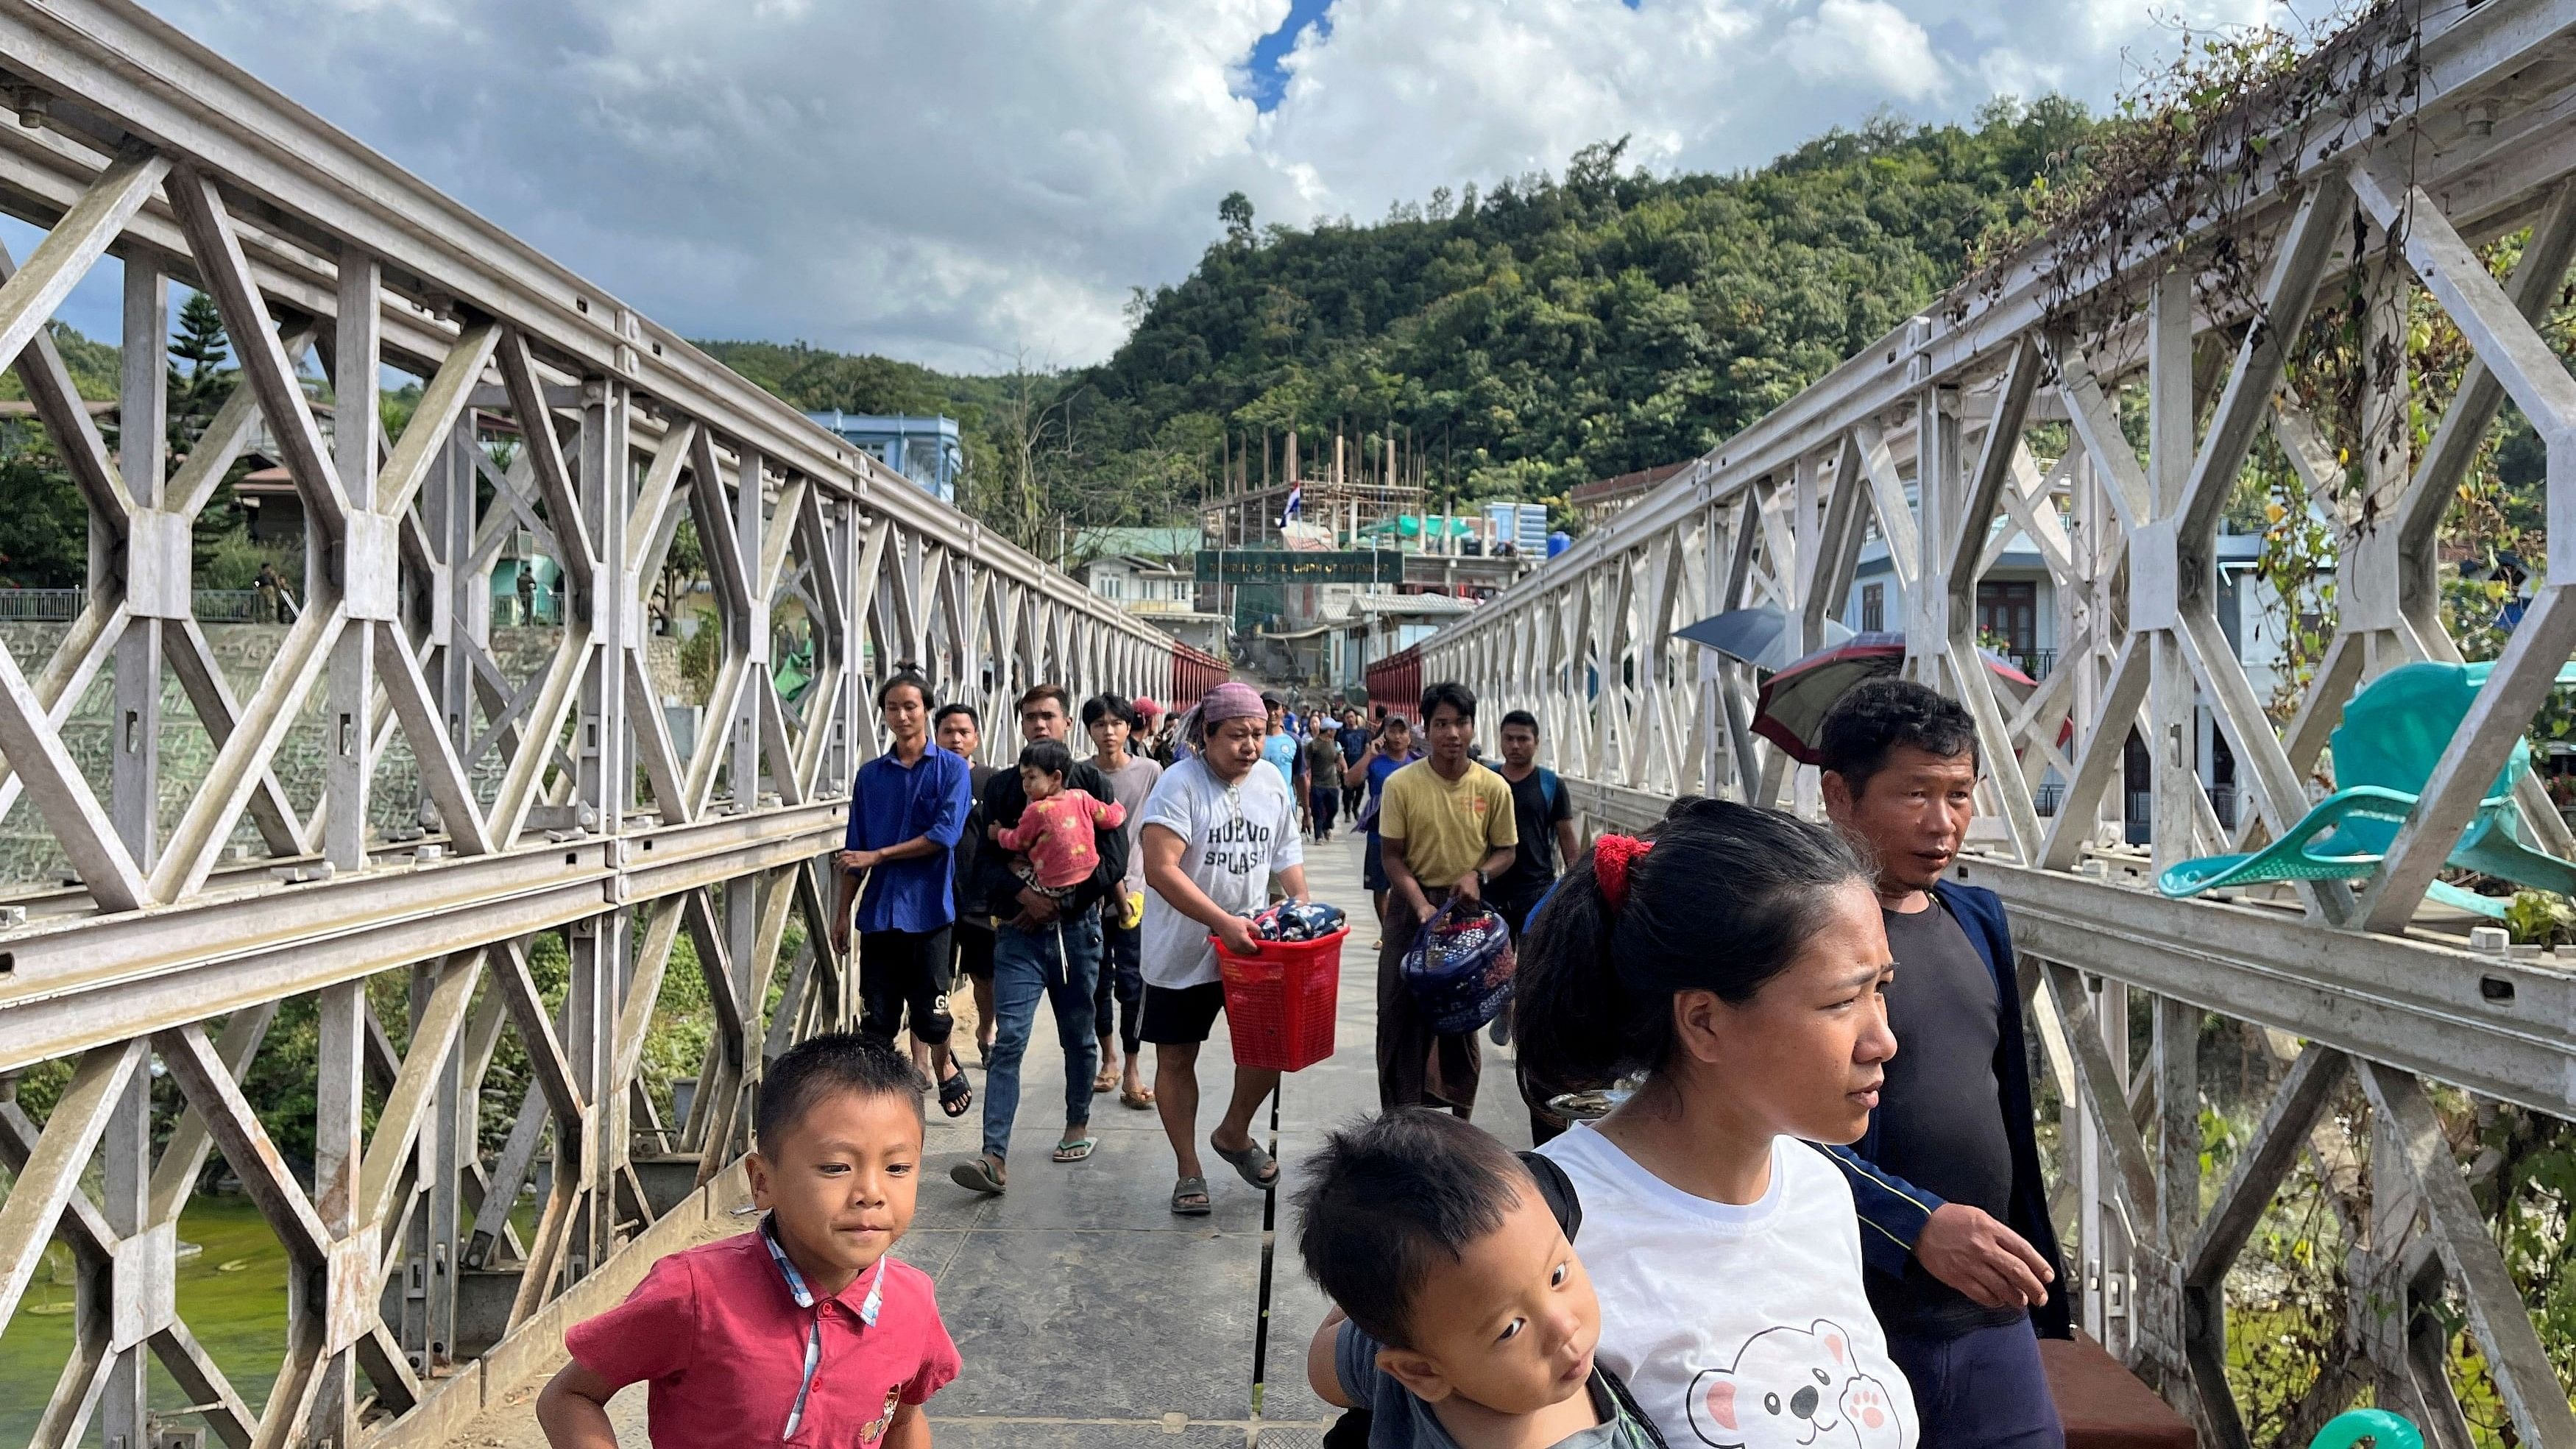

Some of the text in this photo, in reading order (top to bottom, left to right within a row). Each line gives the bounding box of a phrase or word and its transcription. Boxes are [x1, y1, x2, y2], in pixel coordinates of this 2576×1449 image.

[1255, 564, 1266, 573] OF
[1271, 564, 1288, 573] THE
[1293, 564, 1322, 573] UNION
[1326, 564, 1338, 573] OF
[1208, 818, 1270, 844] HUEVO
[1204, 851, 1266, 875] SPLASH
